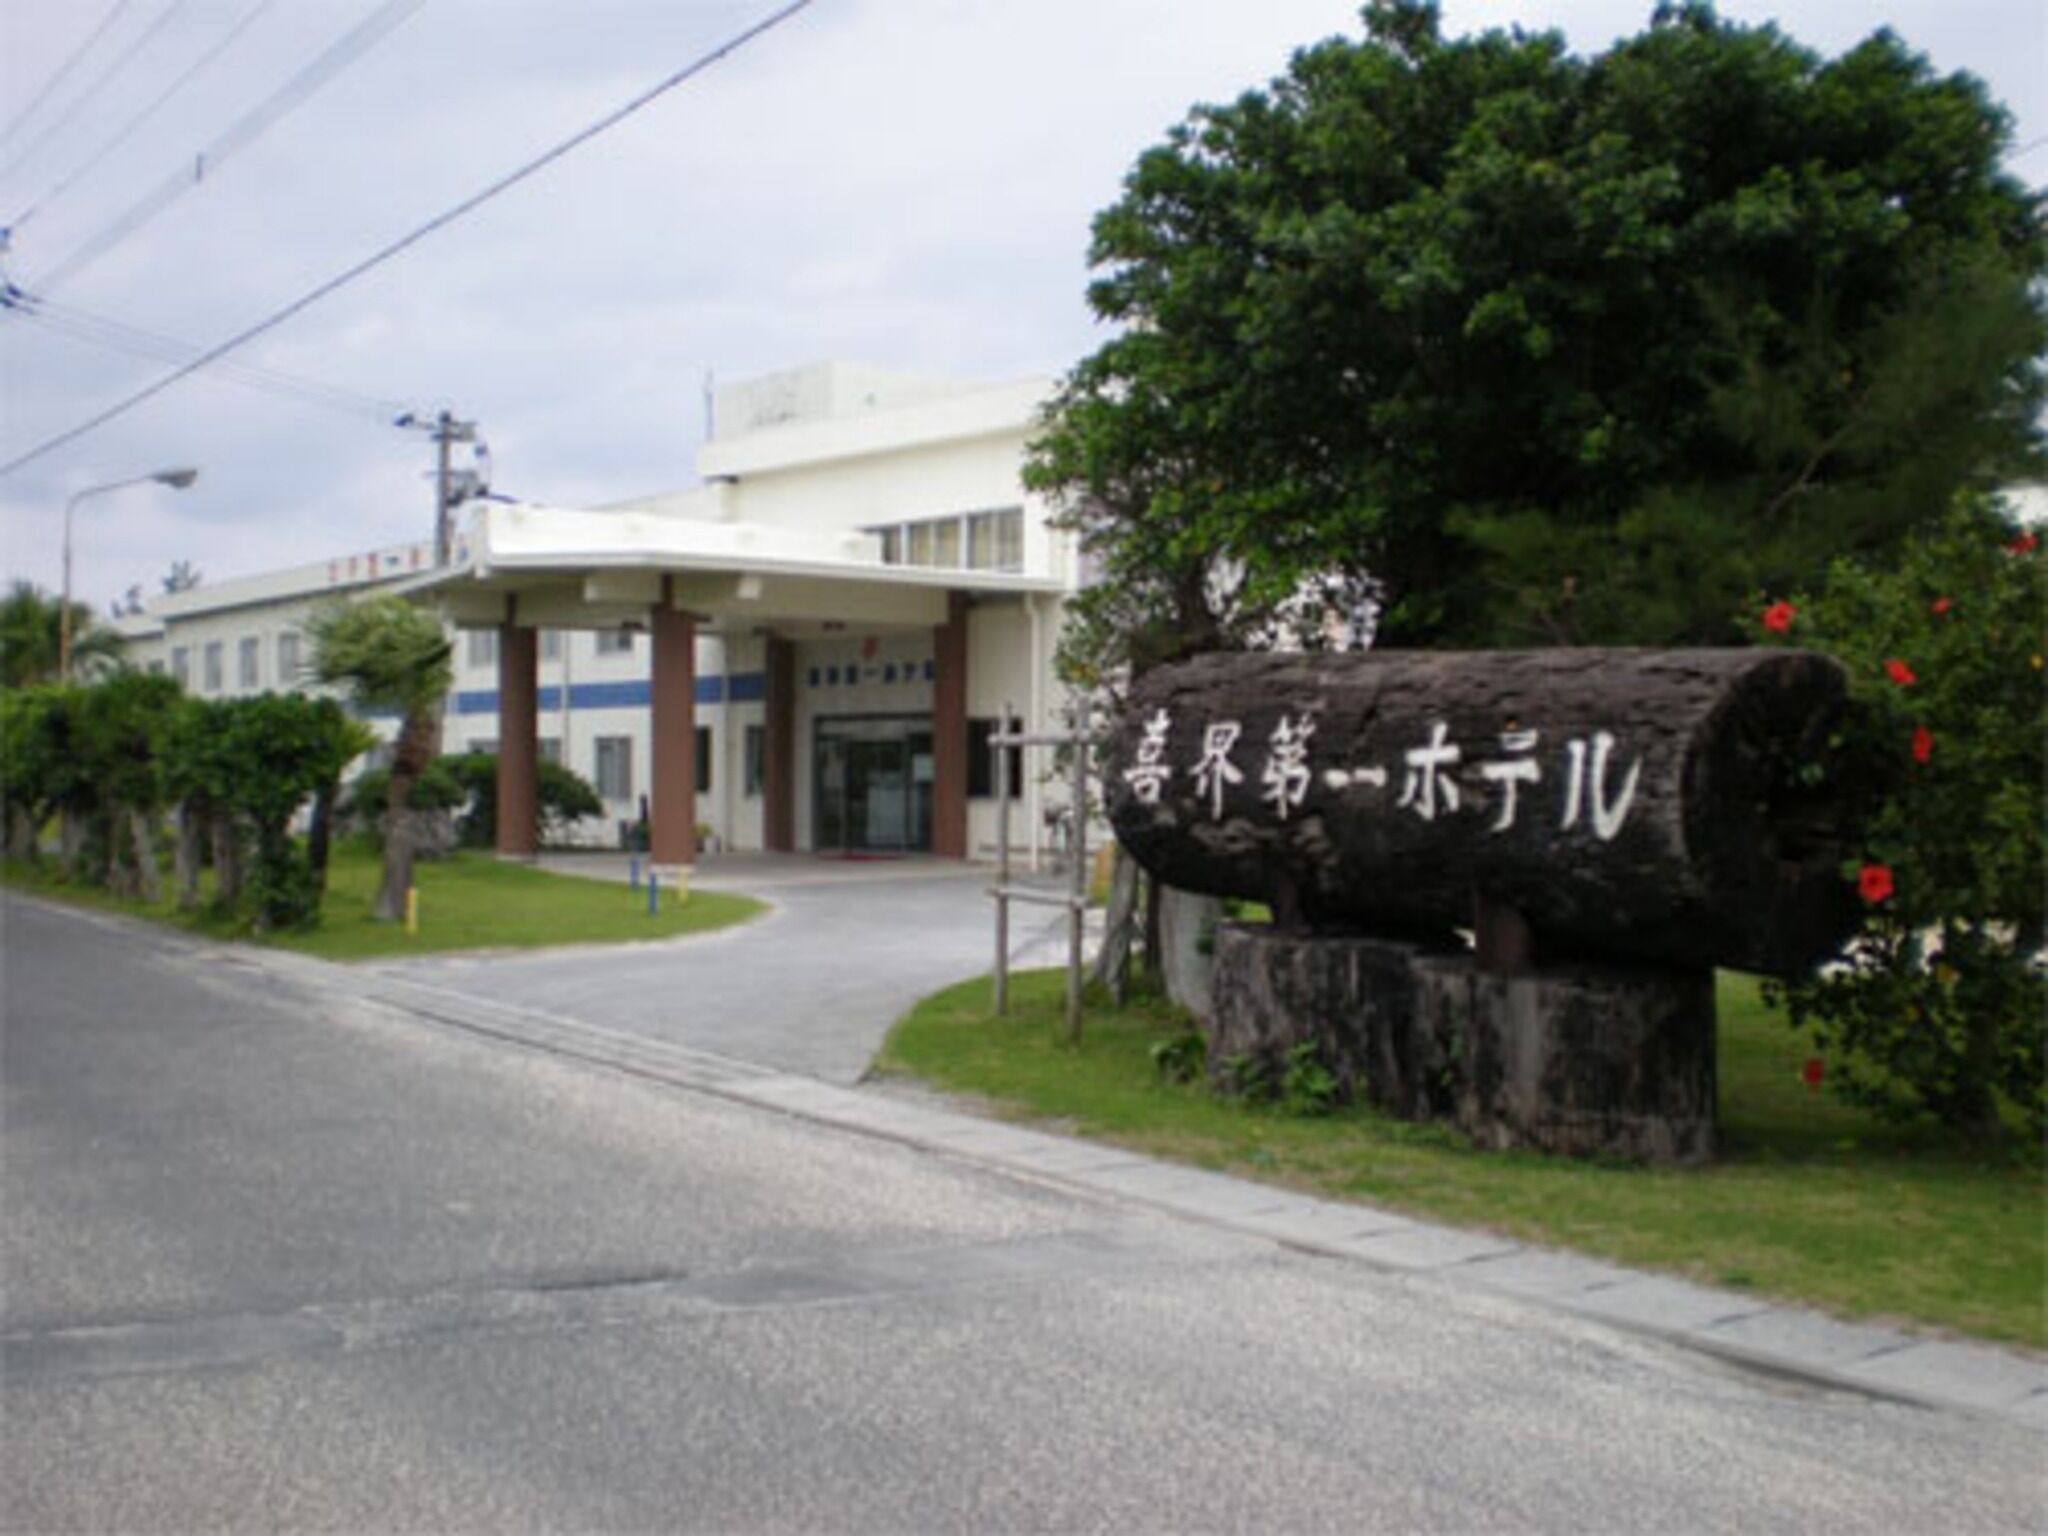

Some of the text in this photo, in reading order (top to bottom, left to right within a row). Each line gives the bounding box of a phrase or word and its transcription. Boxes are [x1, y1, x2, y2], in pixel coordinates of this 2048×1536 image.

[1122, 708, 1642, 841] 喜界第一ホテル
